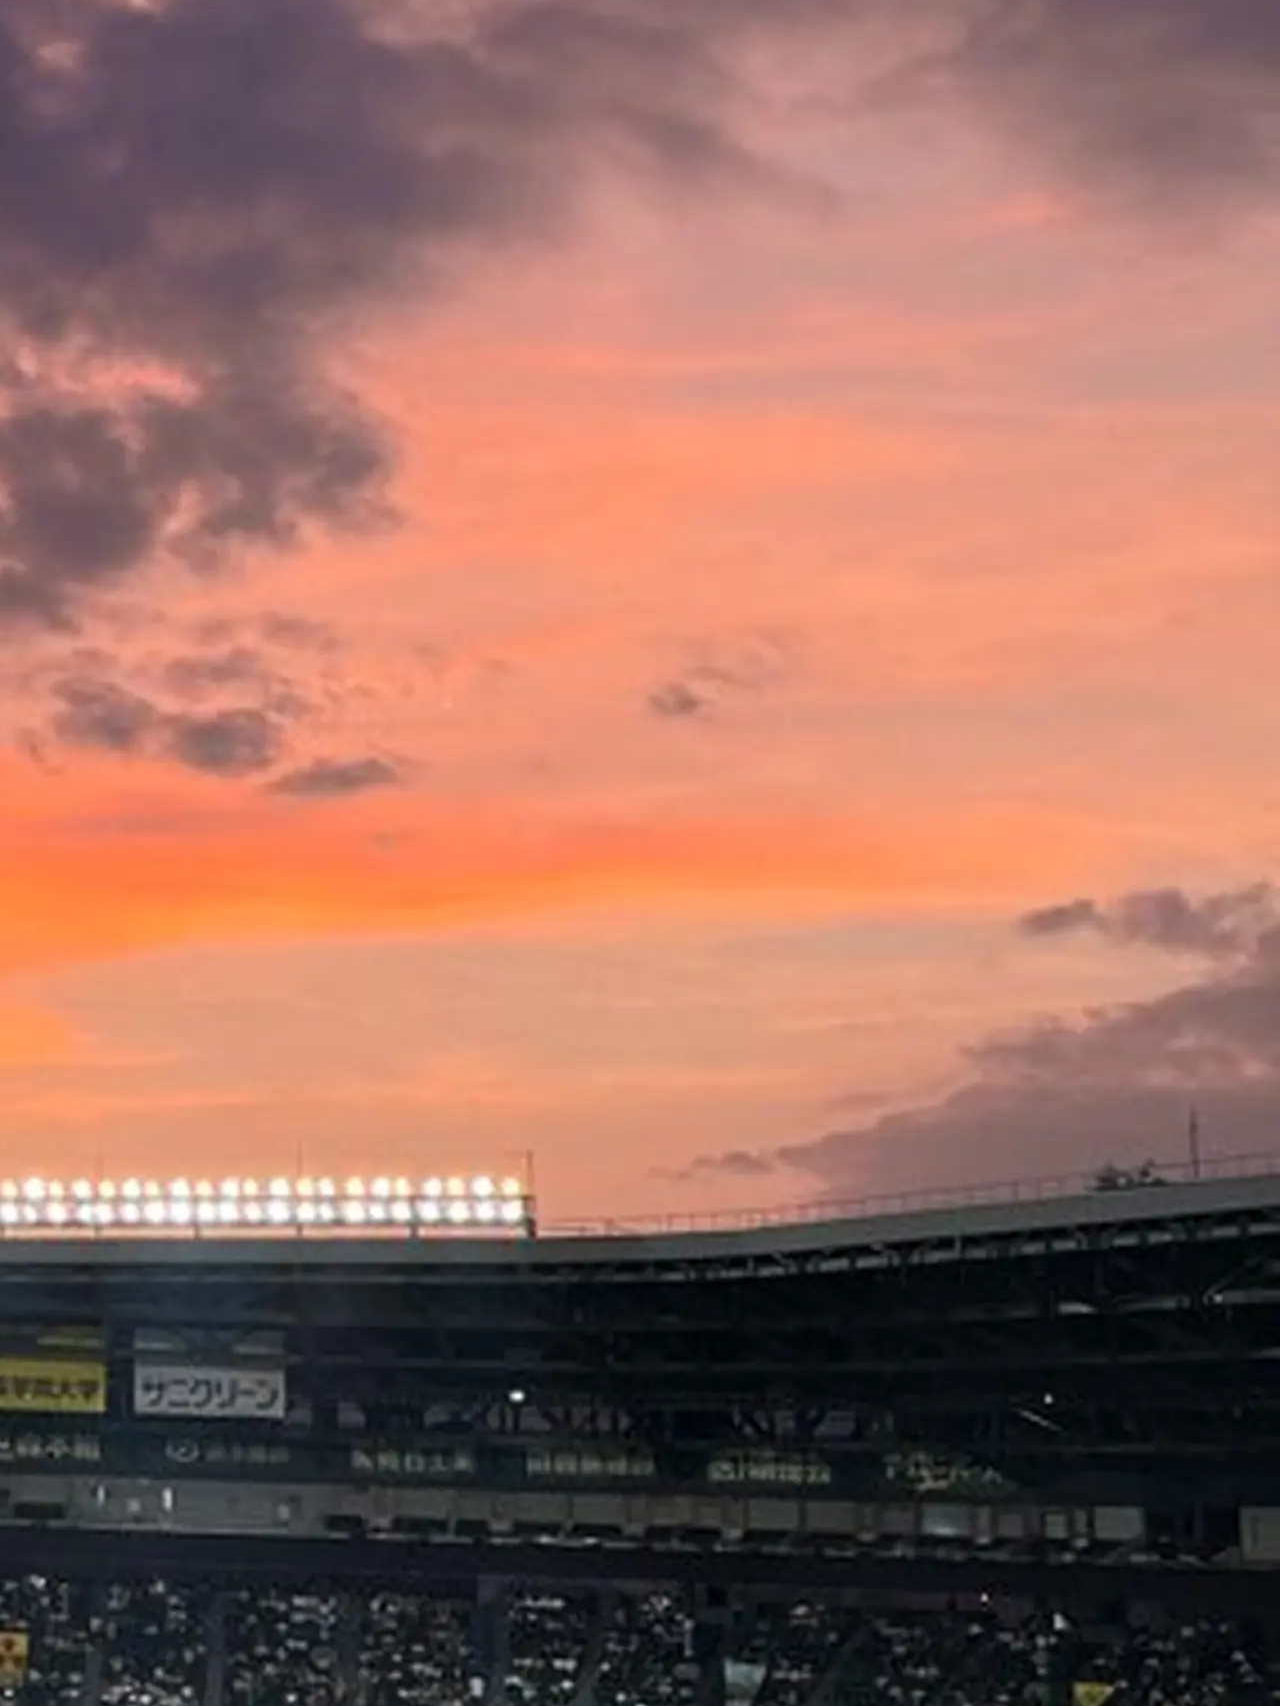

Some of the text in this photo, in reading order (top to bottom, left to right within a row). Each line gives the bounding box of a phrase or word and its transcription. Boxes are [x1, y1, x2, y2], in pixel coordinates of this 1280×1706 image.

[143, 1379, 278, 1410] サニクリーン
